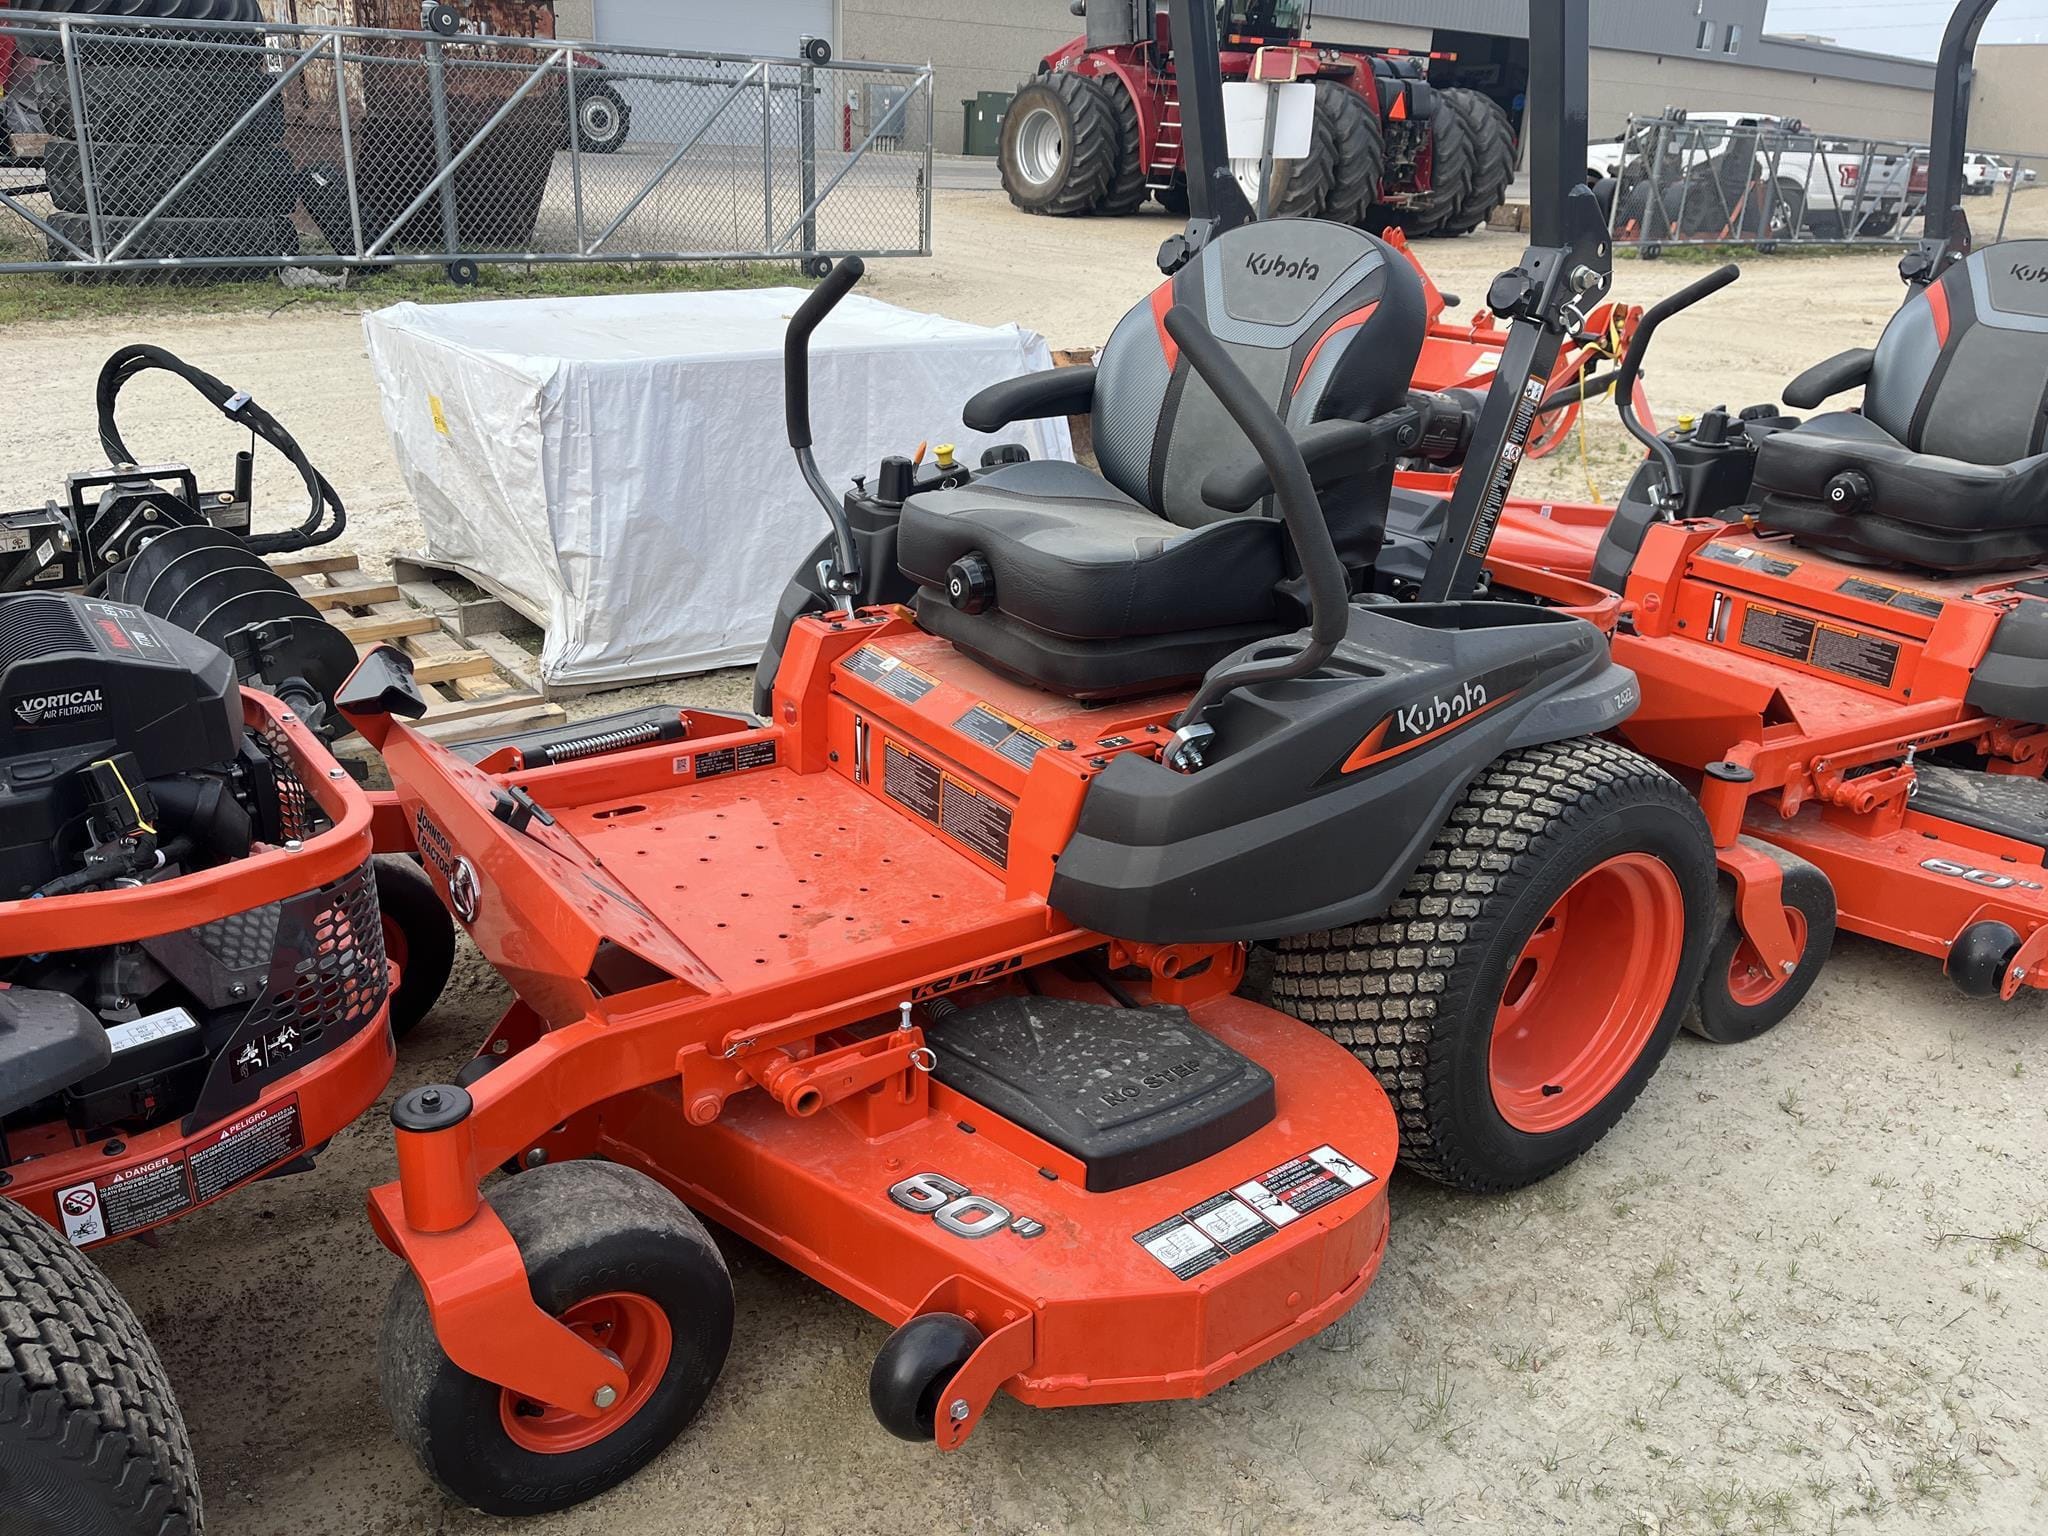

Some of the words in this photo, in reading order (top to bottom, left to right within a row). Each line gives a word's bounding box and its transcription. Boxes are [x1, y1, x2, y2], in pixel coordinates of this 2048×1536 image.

[1246, 252, 1320, 281] Kubota
[22, 689, 103, 711] VORTICAL
[44, 709, 57, 720] AIR
[59, 702, 103, 717] FILTRATION
[1398, 682, 1486, 735] Kubota
[416, 805, 452, 858] JOHNSON
[416, 823, 451, 879] TRACTOR
[915, 954, 1021, 999] K-LIFT
[1099, 1086, 1141, 1108] NO
[1141, 1060, 1201, 1090] STEP
[229, 1110, 268, 1134] PELIGRO
[125, 1157, 169, 1179] DANGER
[1271, 1159, 1301, 1175] DANGER
[1297, 1176, 1327, 1193] PELIGRO
[887, 1171, 1046, 1239] 60"
